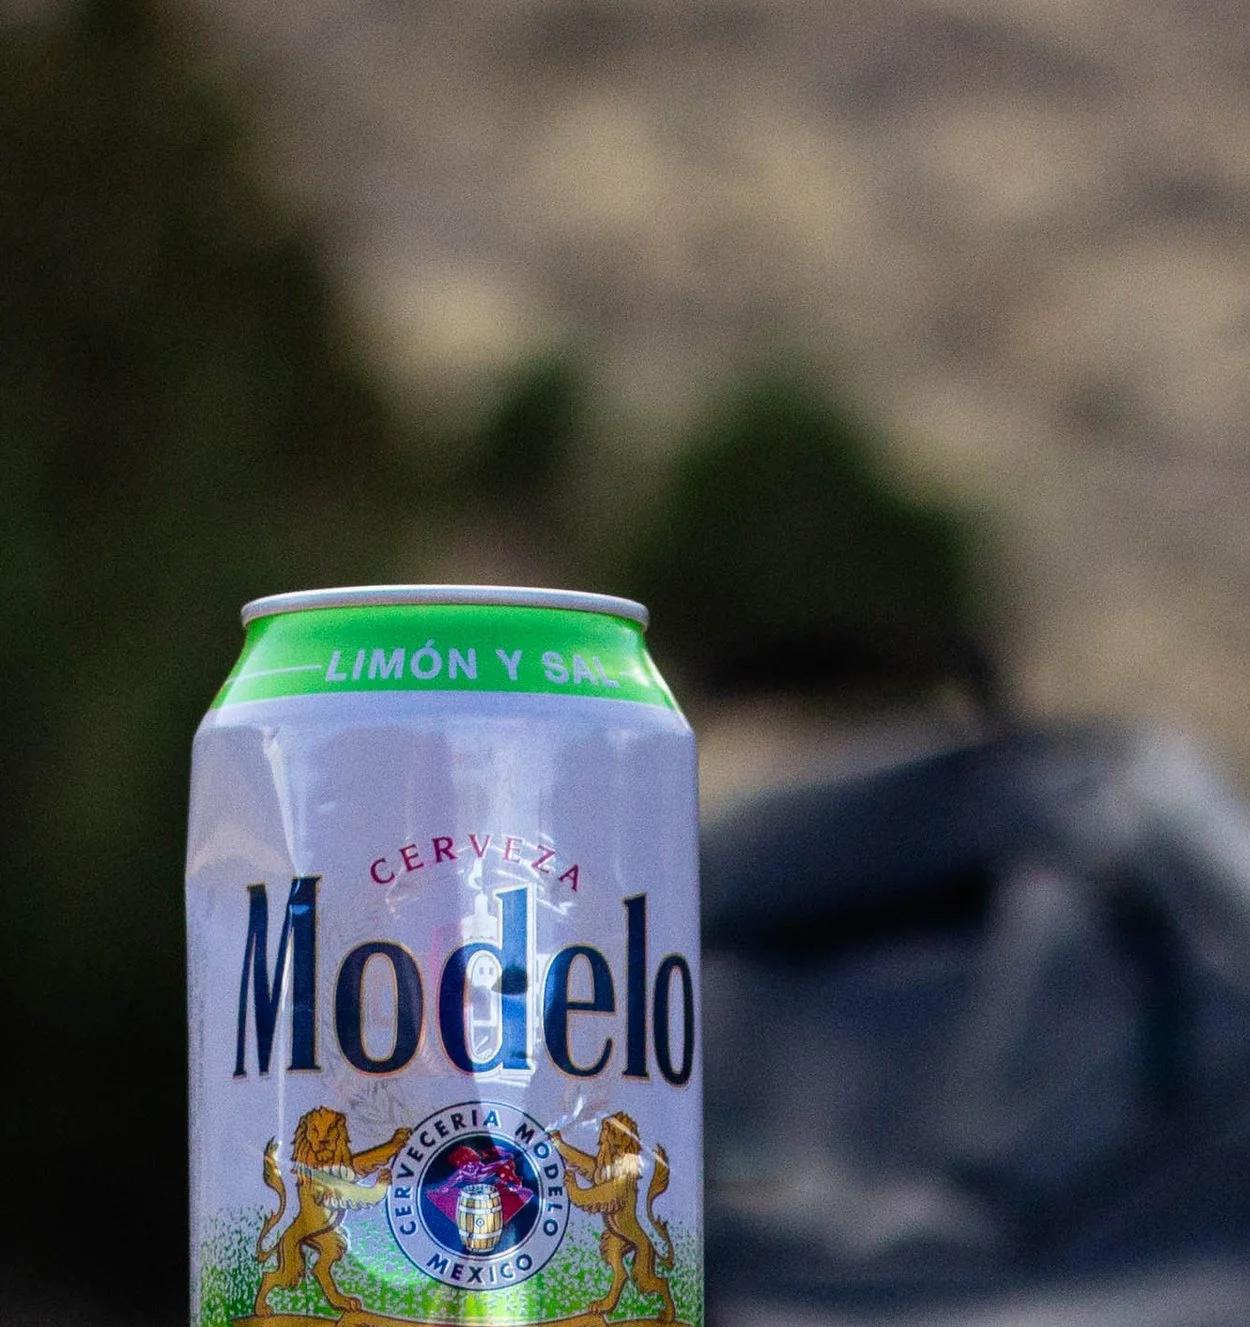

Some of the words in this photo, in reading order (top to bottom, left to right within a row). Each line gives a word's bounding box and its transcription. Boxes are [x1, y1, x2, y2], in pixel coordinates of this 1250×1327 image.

[325, 638, 478, 682] LIMÓN
[495, 649, 522, 681] Y
[541, 651, 621, 689] SAL
[370, 833, 582, 893] CERVEZA
[232, 873, 696, 1088] Modelo
[394, 1109, 500, 1236] CERVECERIA
[514, 1122, 563, 1237] MODELO
[426, 1253, 533, 1284] MEXICO
